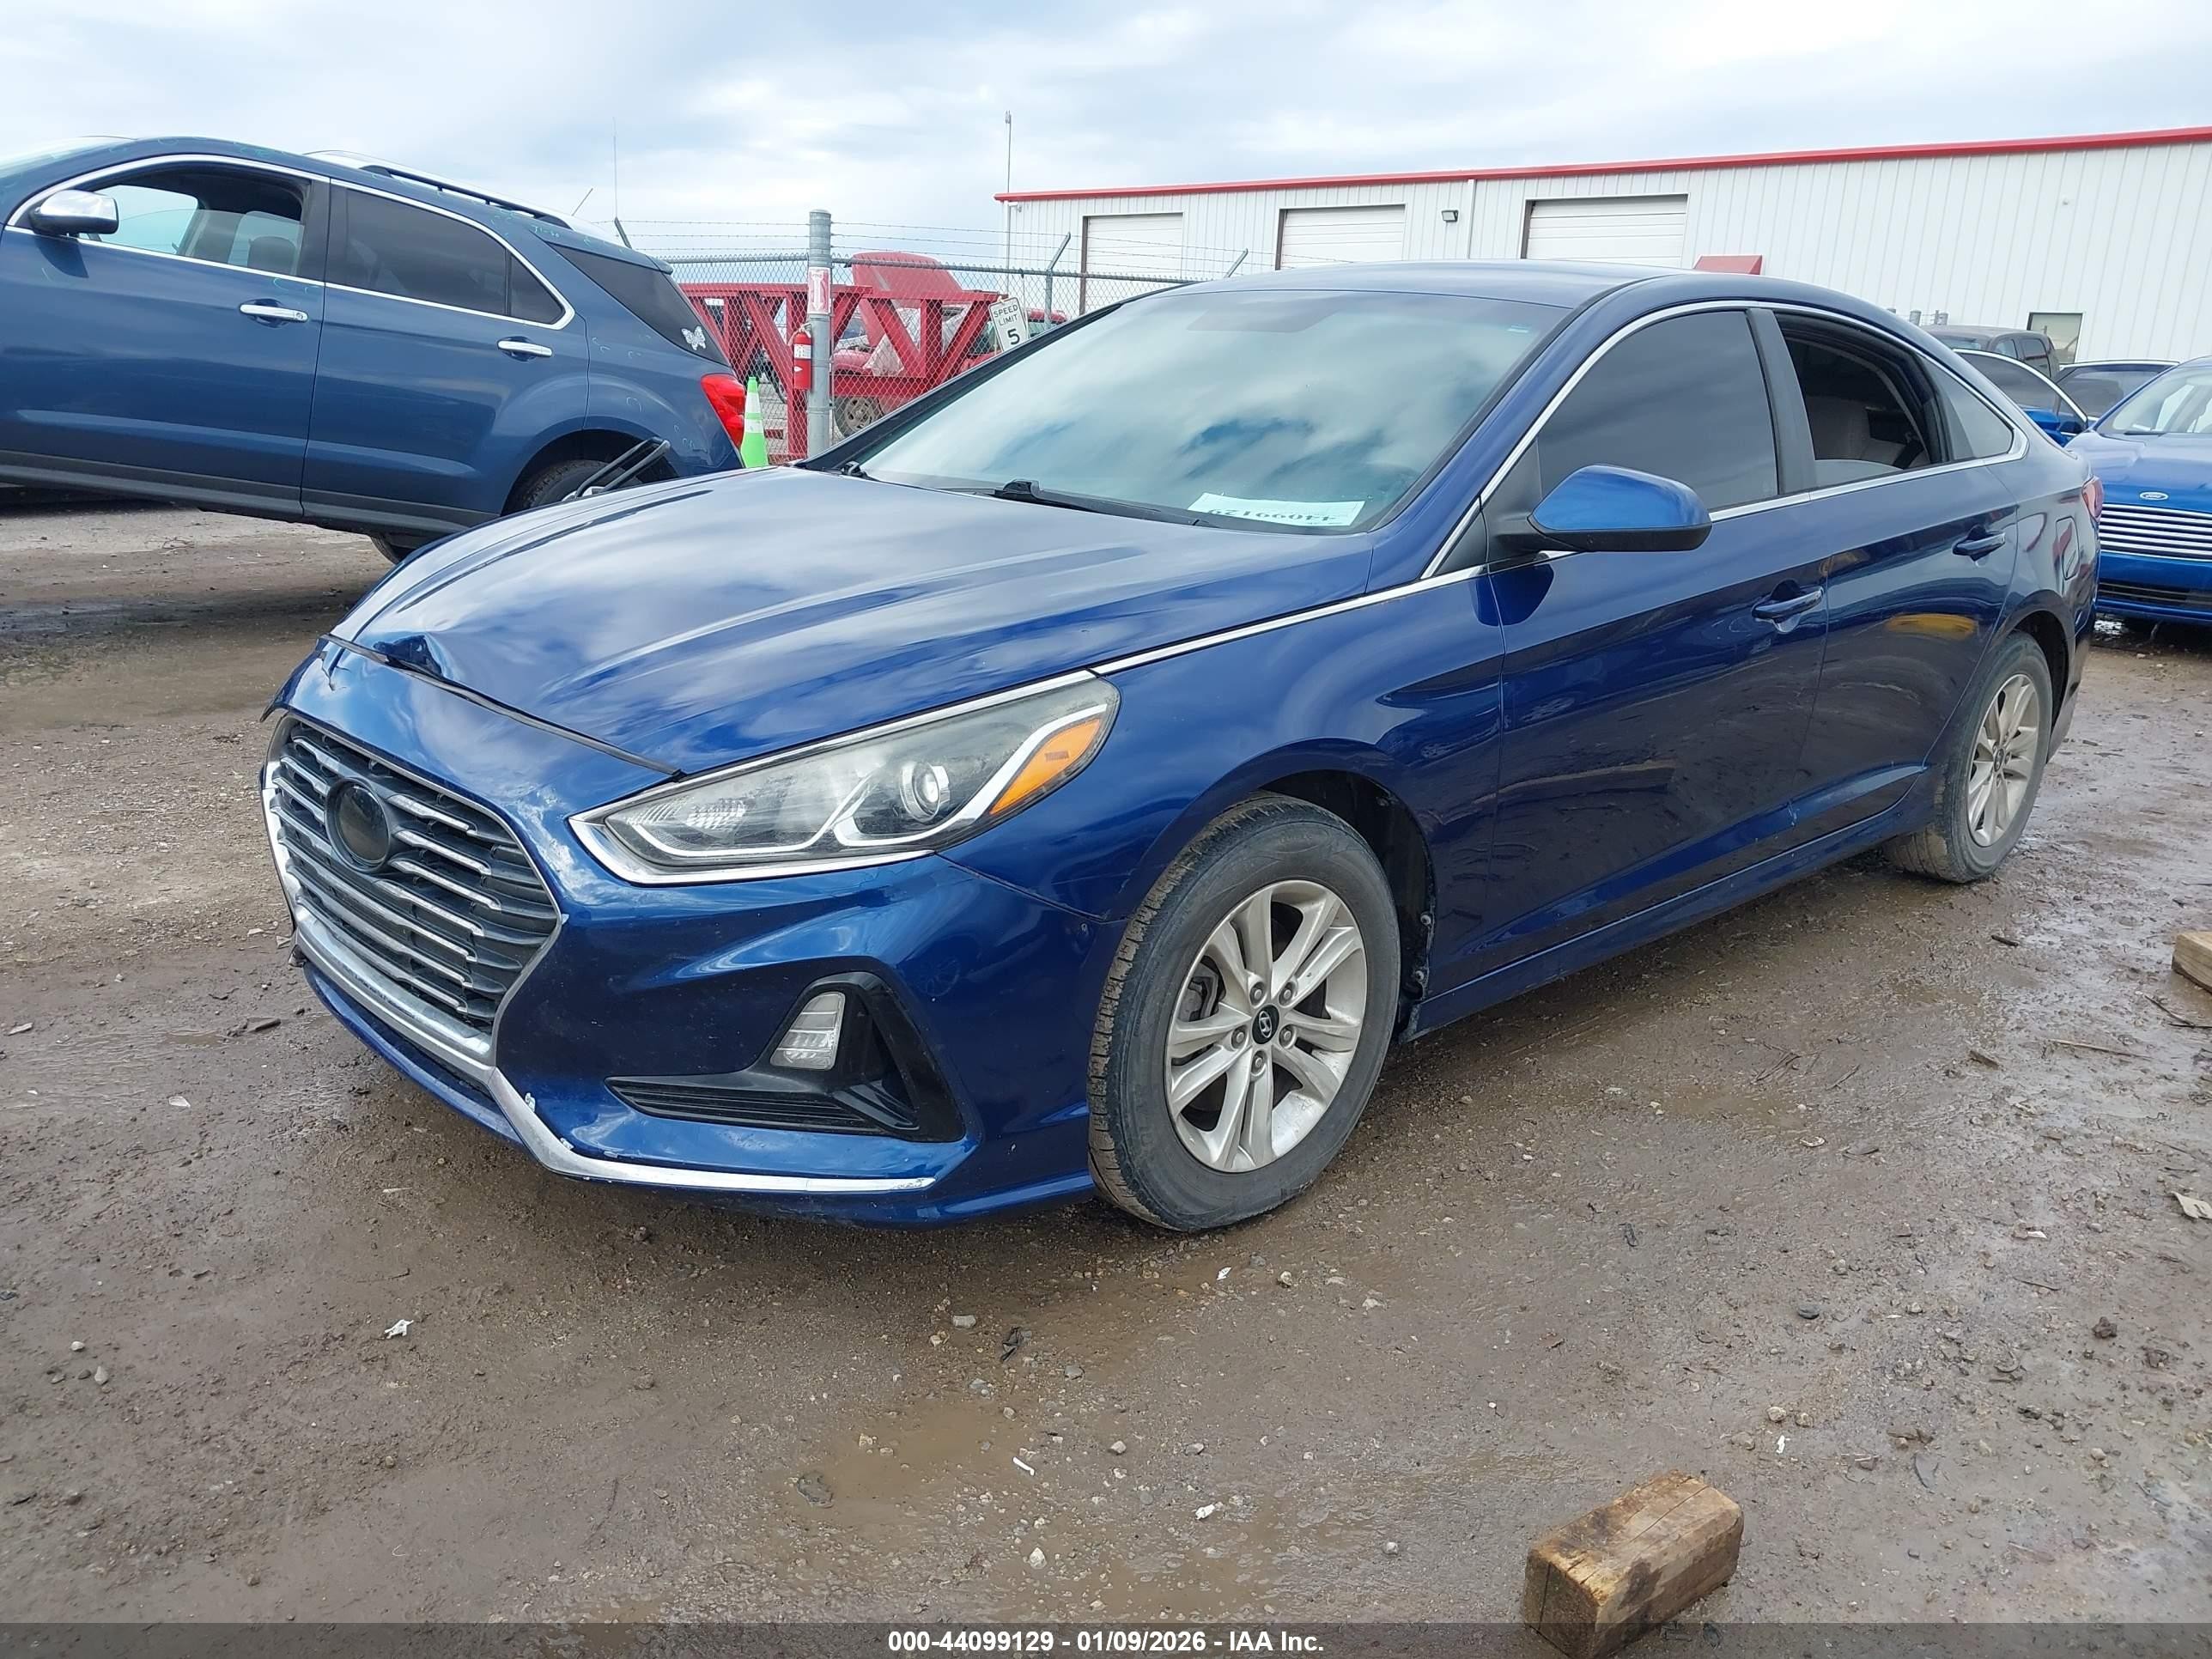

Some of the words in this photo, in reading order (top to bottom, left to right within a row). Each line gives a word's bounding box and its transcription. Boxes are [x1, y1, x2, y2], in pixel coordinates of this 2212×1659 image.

[994, 304, 1018, 318] SPEED
[999, 313, 1018, 326] LIMIT
[1007, 328, 1020, 345] 5
